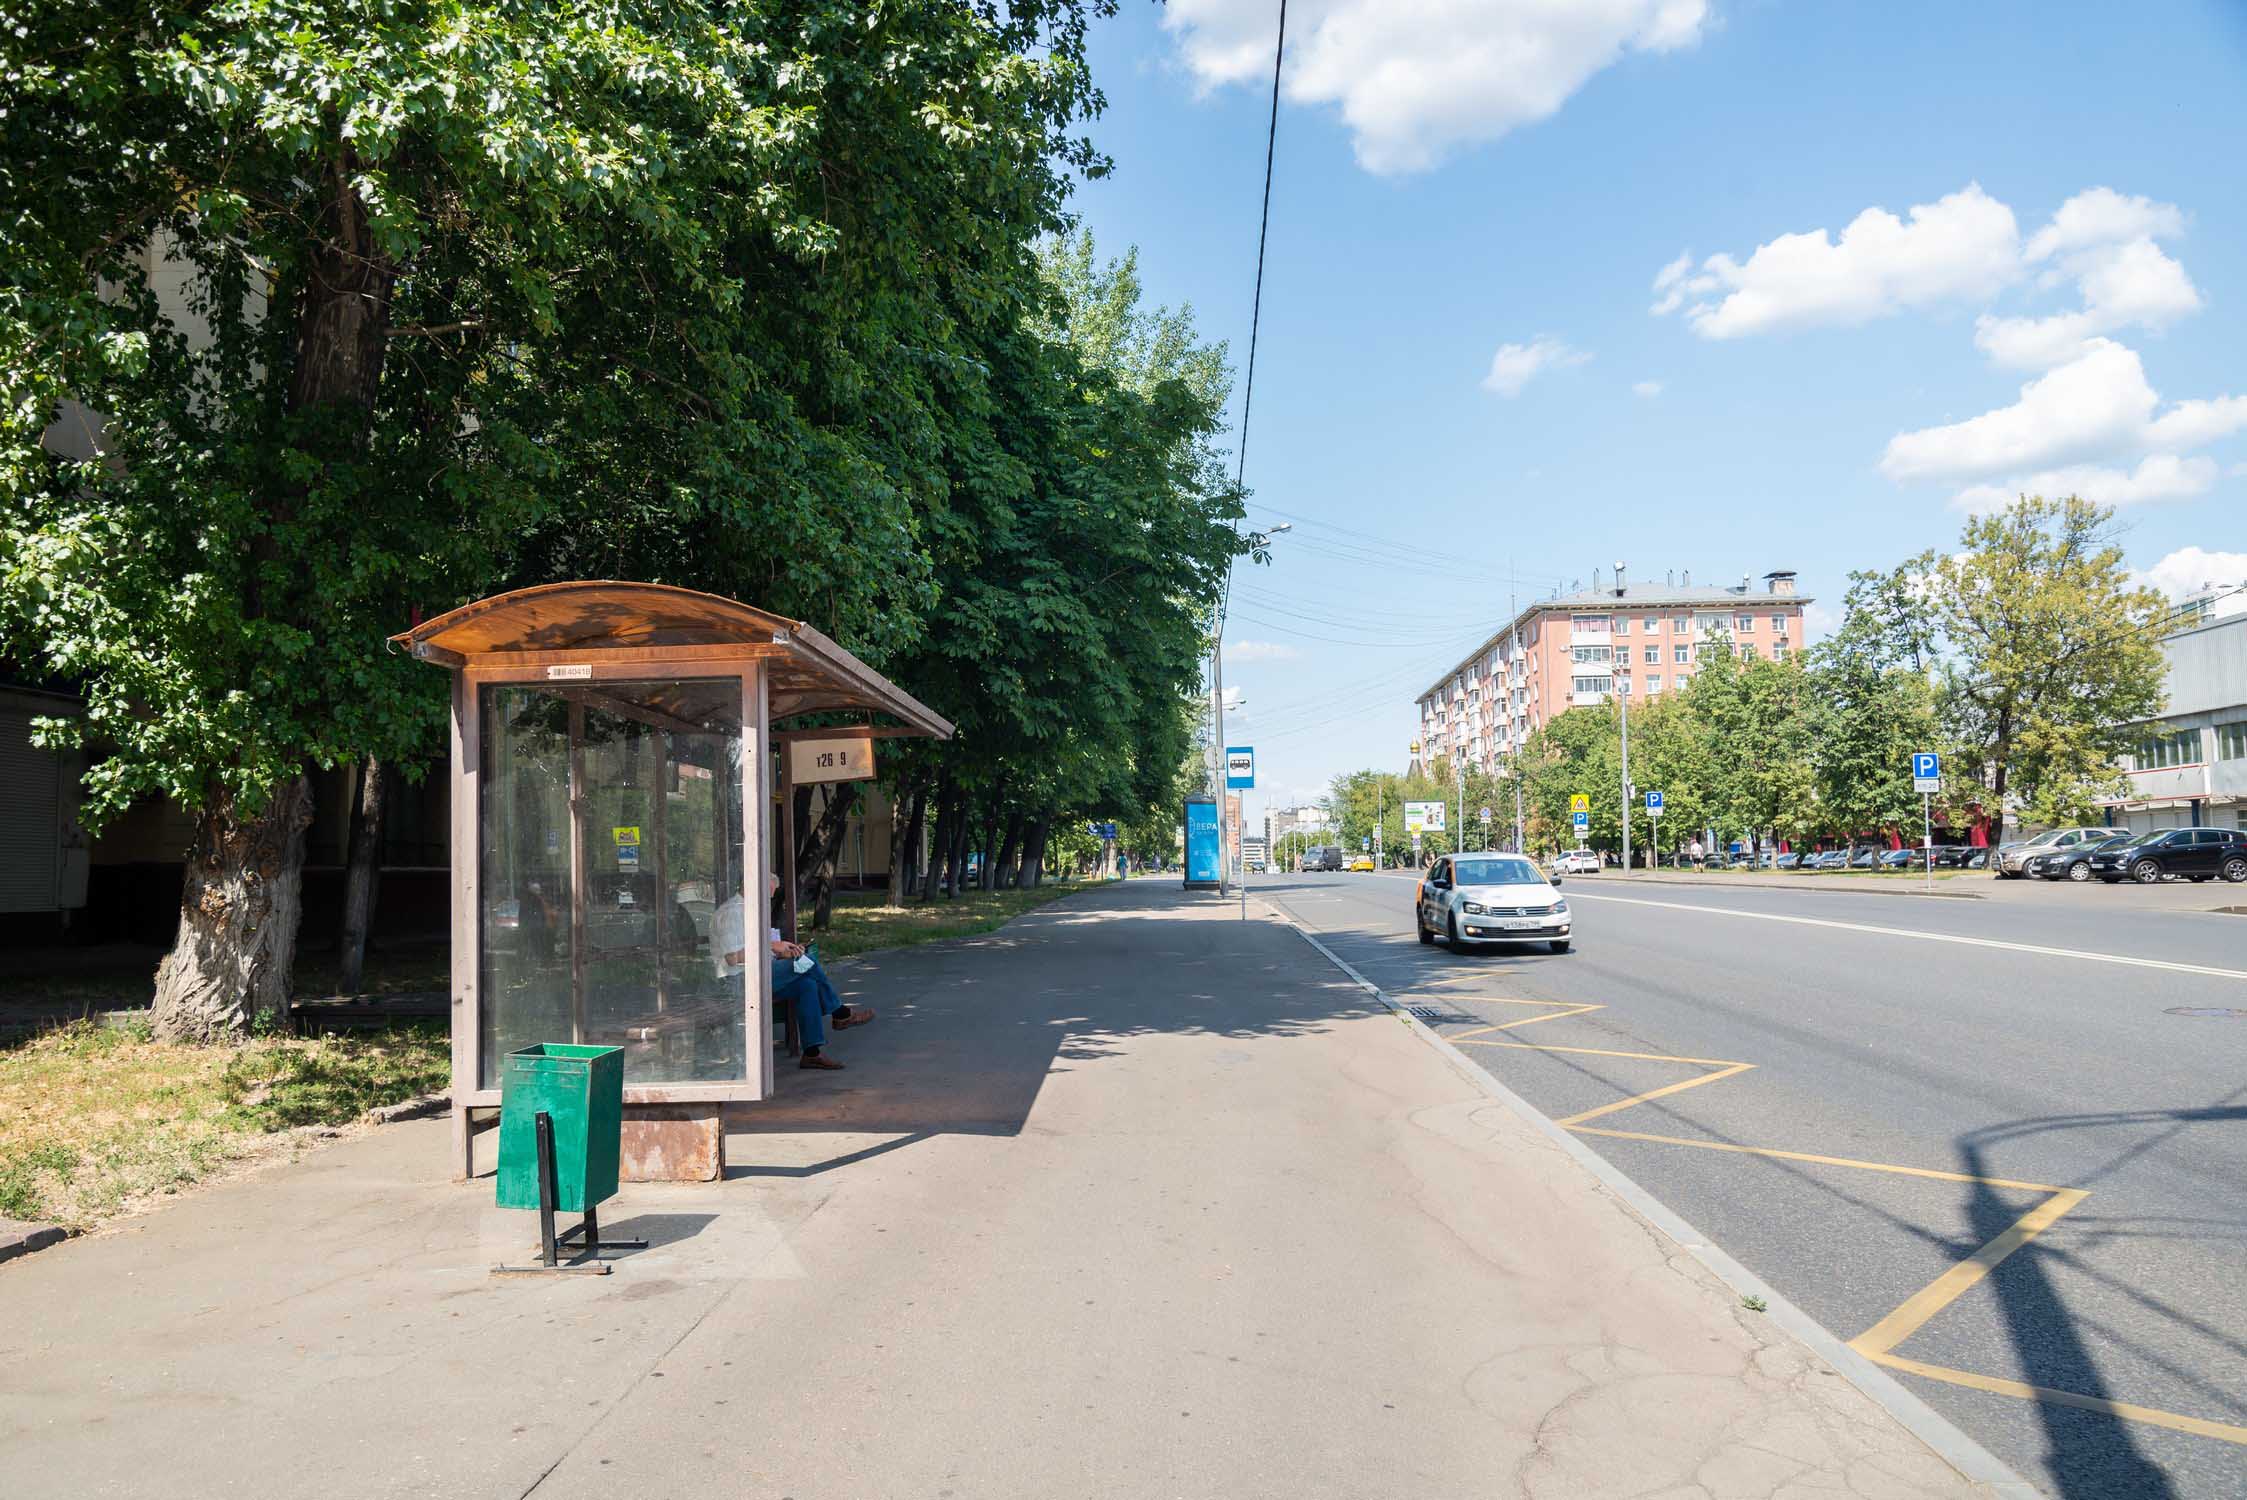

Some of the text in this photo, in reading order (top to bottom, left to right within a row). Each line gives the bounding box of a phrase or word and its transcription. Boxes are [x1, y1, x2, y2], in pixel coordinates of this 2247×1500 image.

[840, 751, 846, 766] 9
[1920, 755, 1934, 776] P
[1650, 794, 1659, 806] P
[1577, 813, 1585, 824] P
